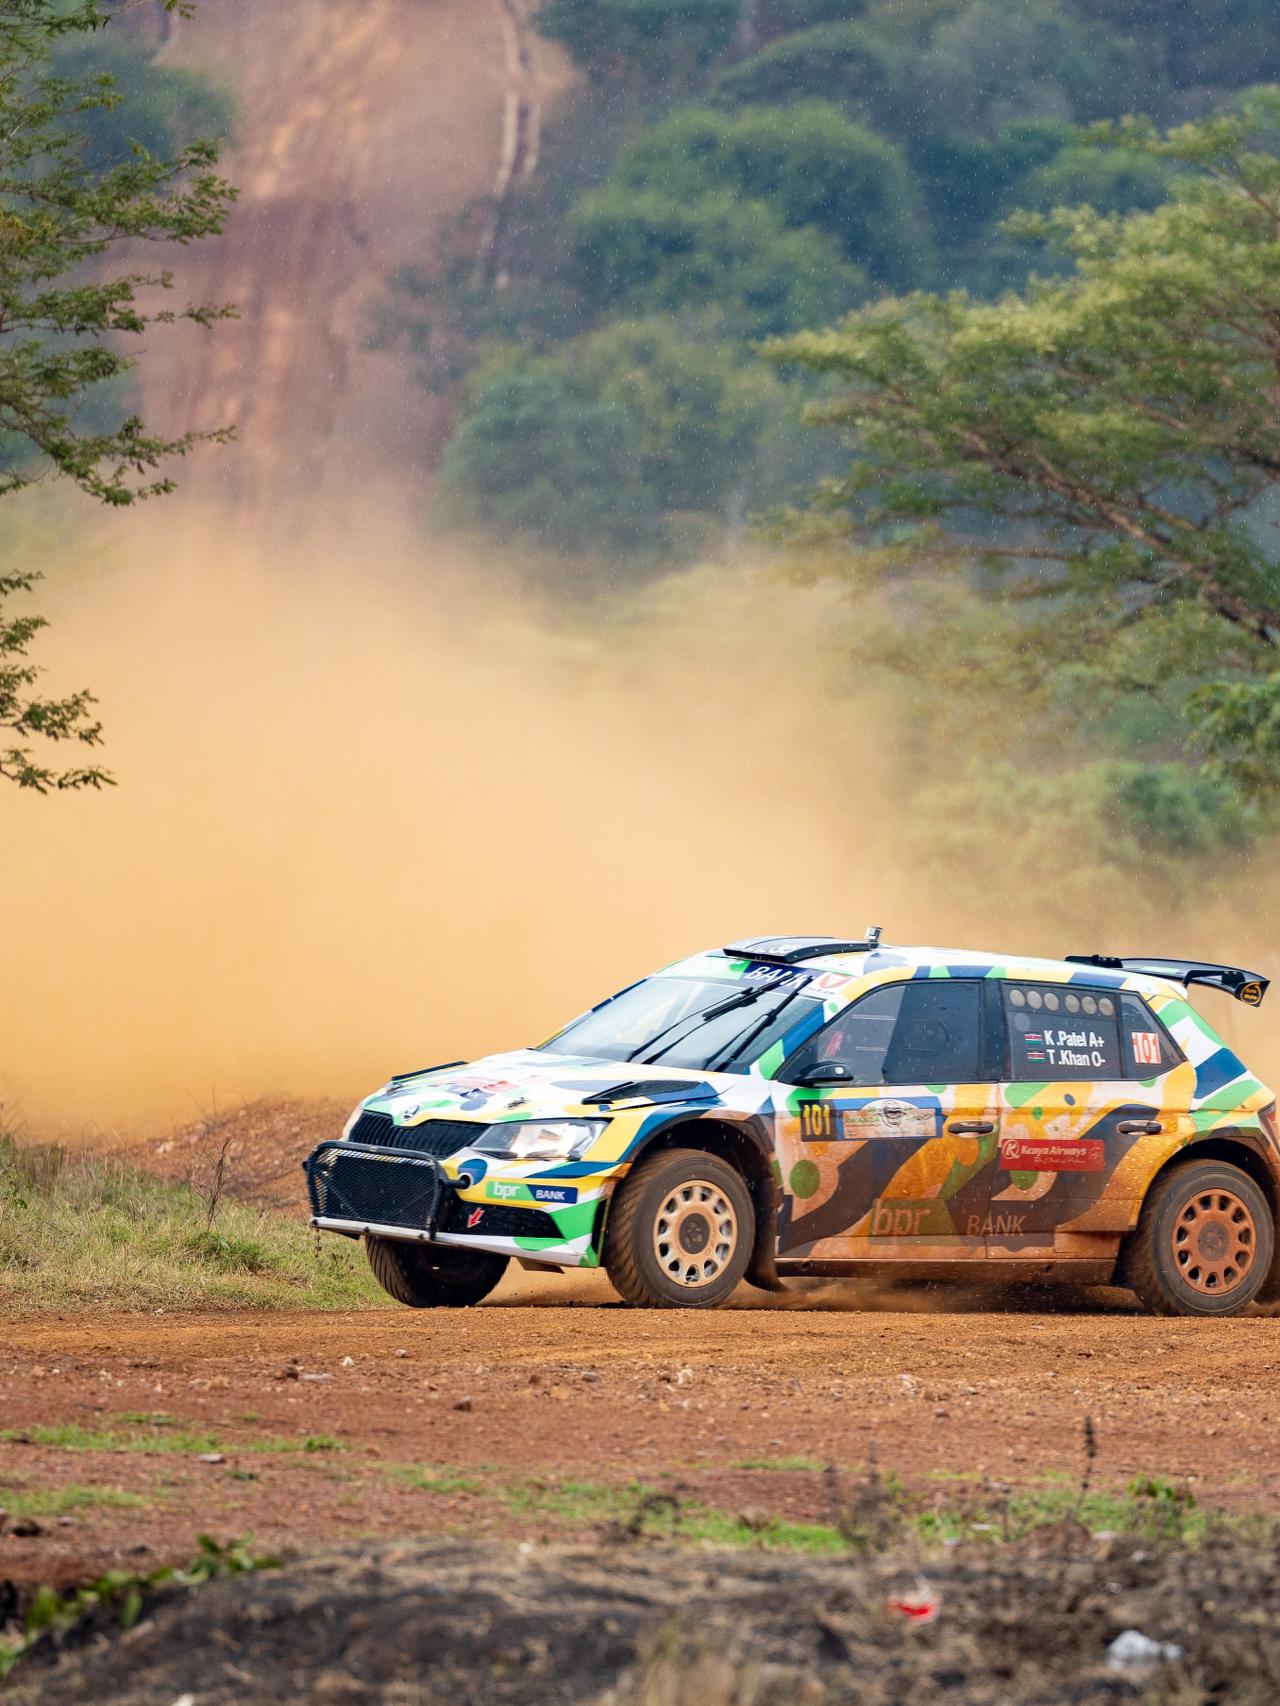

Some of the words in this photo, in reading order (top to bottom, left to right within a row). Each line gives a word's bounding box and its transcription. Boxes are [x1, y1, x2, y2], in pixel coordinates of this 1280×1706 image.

[1044, 1030, 1053, 1046] K
[1089, 1033, 1105, 1047] A+
[1131, 1031, 1161, 1064] 101
[1046, 1049, 1055, 1065] T
[803, 1104, 831, 1136] 101
[1021, 1145, 1049, 1157] Kenya
[1049, 1146, 1087, 1157] Airways
[493, 1181, 520, 1199] bpr
[536, 1190, 565, 1200] BANK
[873, 1199, 931, 1242] bpr
[966, 1213, 1027, 1237] BANK
